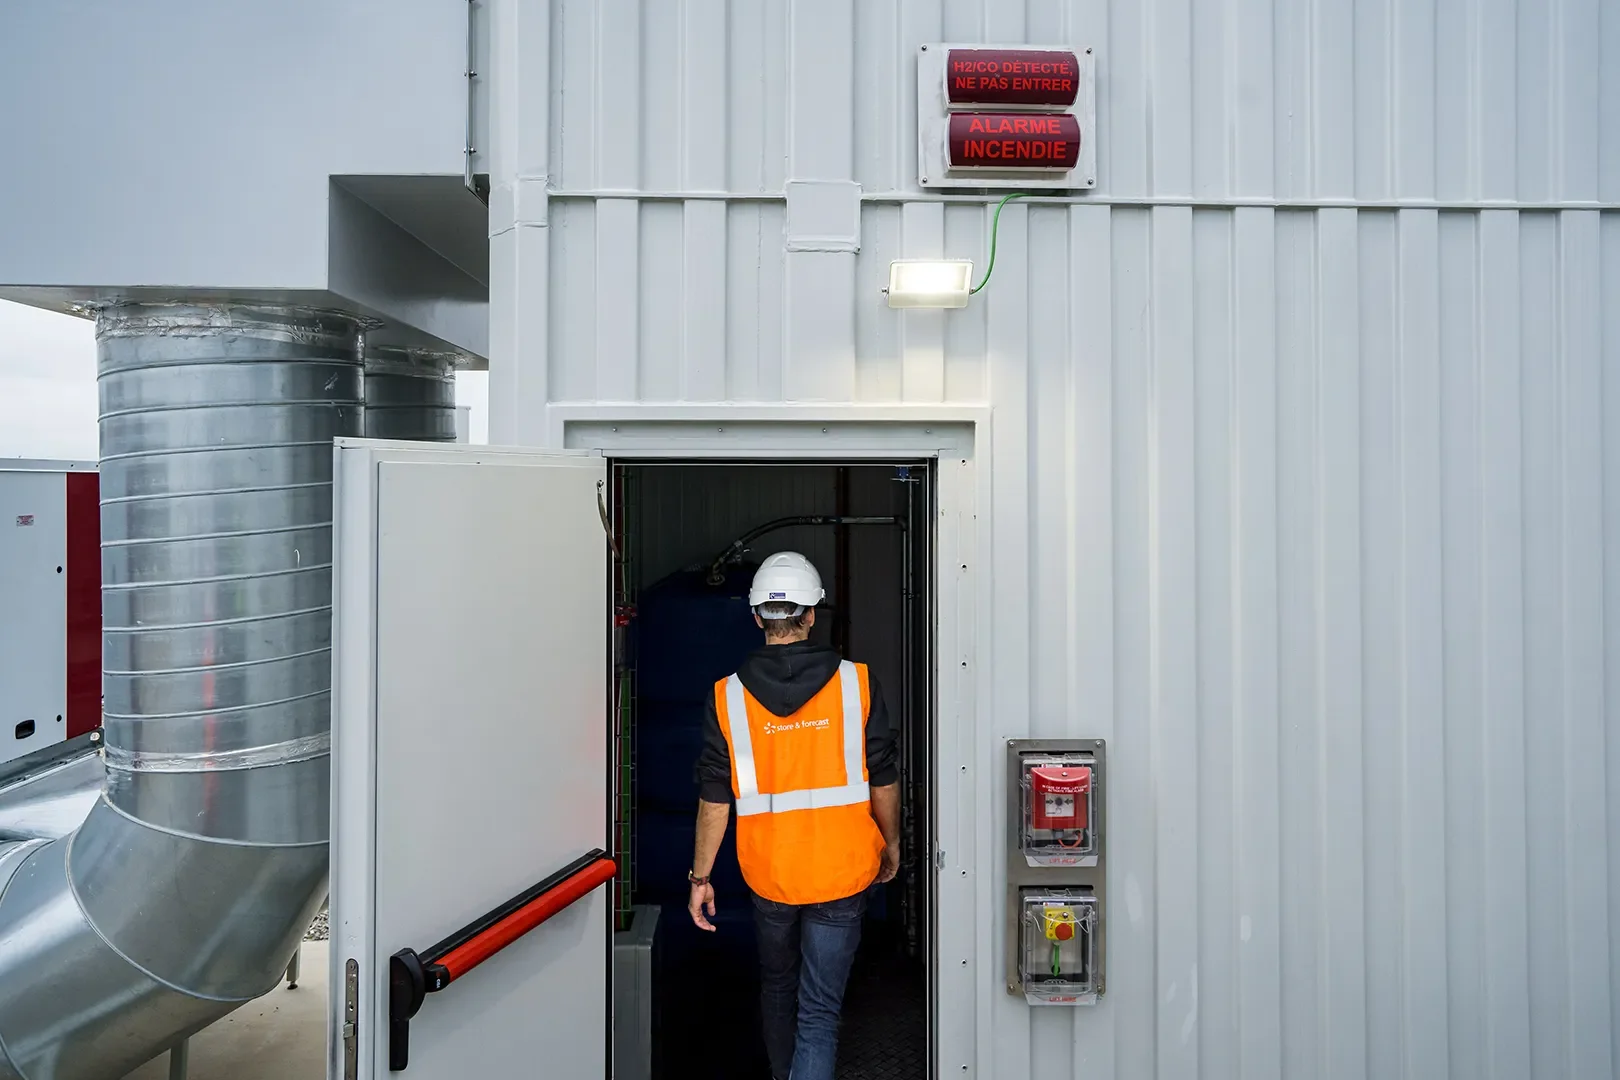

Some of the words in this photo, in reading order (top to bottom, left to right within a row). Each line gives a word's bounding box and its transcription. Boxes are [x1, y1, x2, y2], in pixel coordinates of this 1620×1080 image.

[953, 61, 998, 74] H2/CO
[955, 77, 976, 89] NE
[980, 77, 1008, 90] PAS
[1012, 78, 1072, 91] ENTRER
[969, 118, 1061, 135] ALARME
[963, 140, 1067, 159] INCENDIE
[777, 723, 794, 731] store
[795, 721, 801, 729] &
[801, 718, 830, 727] forecast
